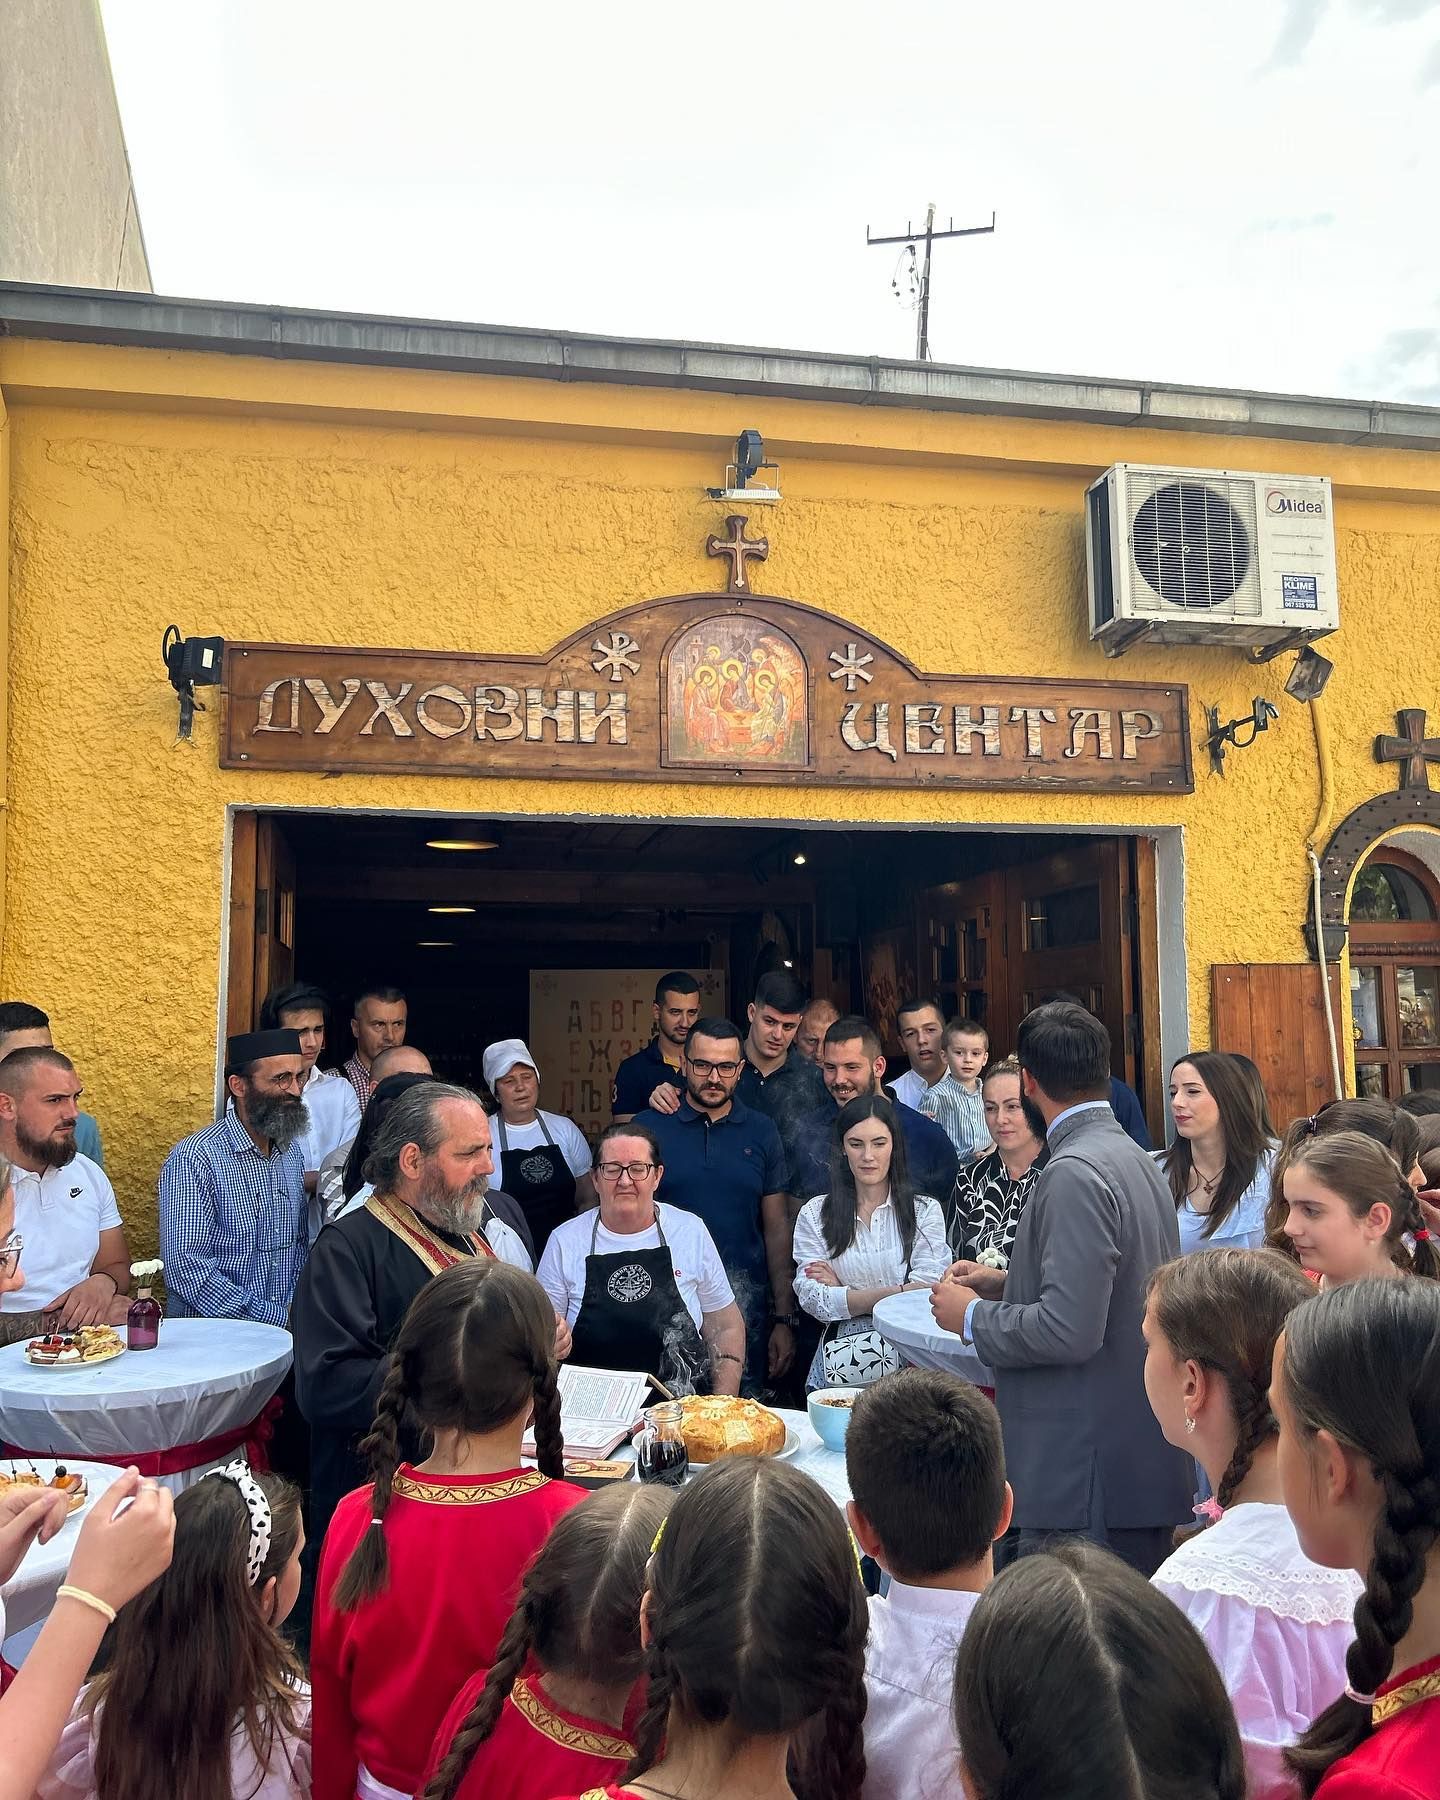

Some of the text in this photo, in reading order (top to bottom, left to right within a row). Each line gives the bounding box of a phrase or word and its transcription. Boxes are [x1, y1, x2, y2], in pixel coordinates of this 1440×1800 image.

[1276, 498, 1322, 514] Midea
[1284, 582, 1315, 591] KLIME
[252, 676, 1165, 762] ДУХОВНИ ЦЕНТАР
